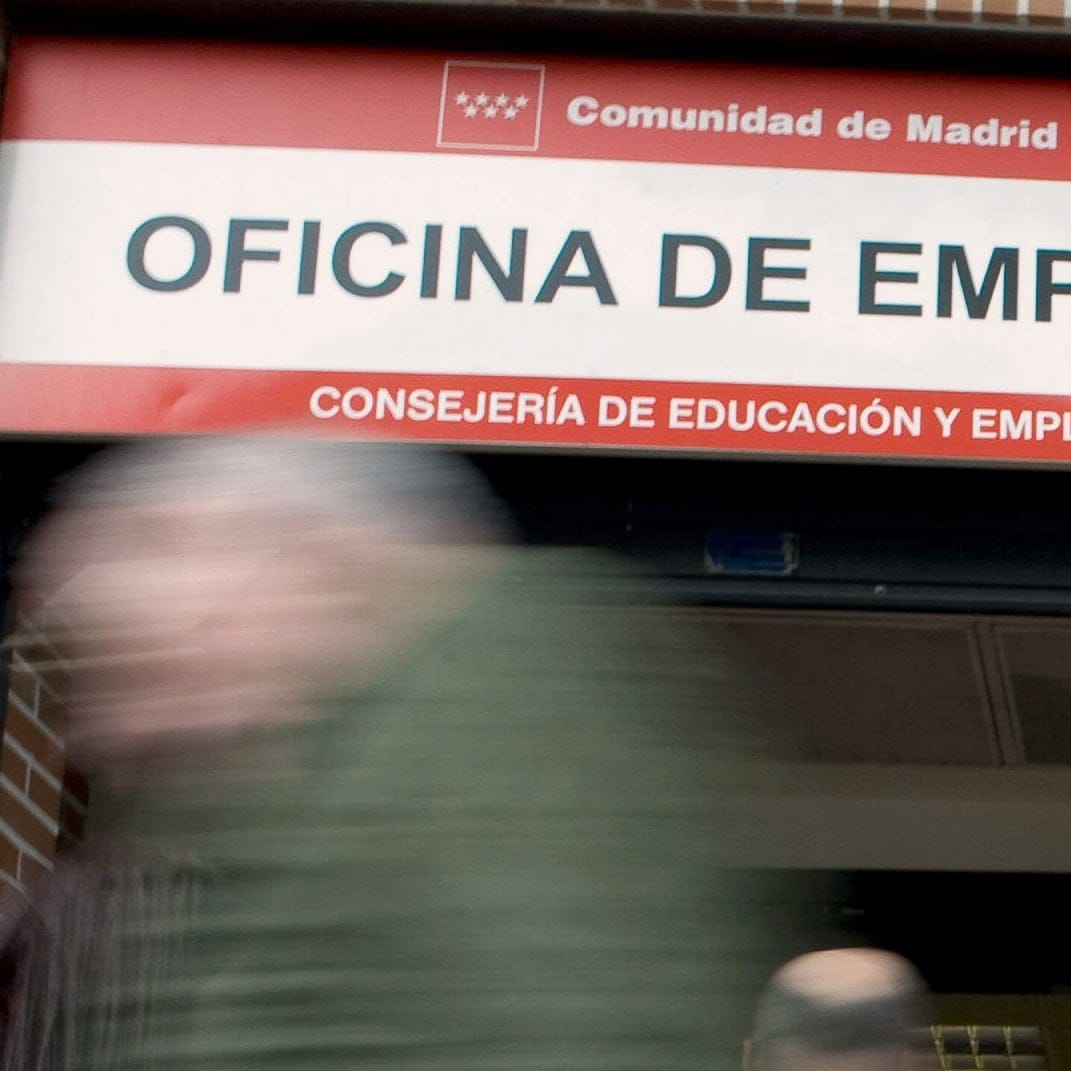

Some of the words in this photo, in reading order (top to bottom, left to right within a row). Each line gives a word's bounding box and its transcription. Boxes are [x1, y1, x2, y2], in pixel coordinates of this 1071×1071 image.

[566, 95, 823, 137] Comunidad
[836, 110, 892, 141] de
[906, 113, 1058, 150] Madrid
[126, 215, 619, 306] OFICINA
[658, 233, 812, 313] DE
[309, 386, 586, 426] CONSEJERÍA
[598, 395, 657, 428] DE
[668, 397, 922, 437] EDUCACIÓN
[933, 406, 961, 438] Y
